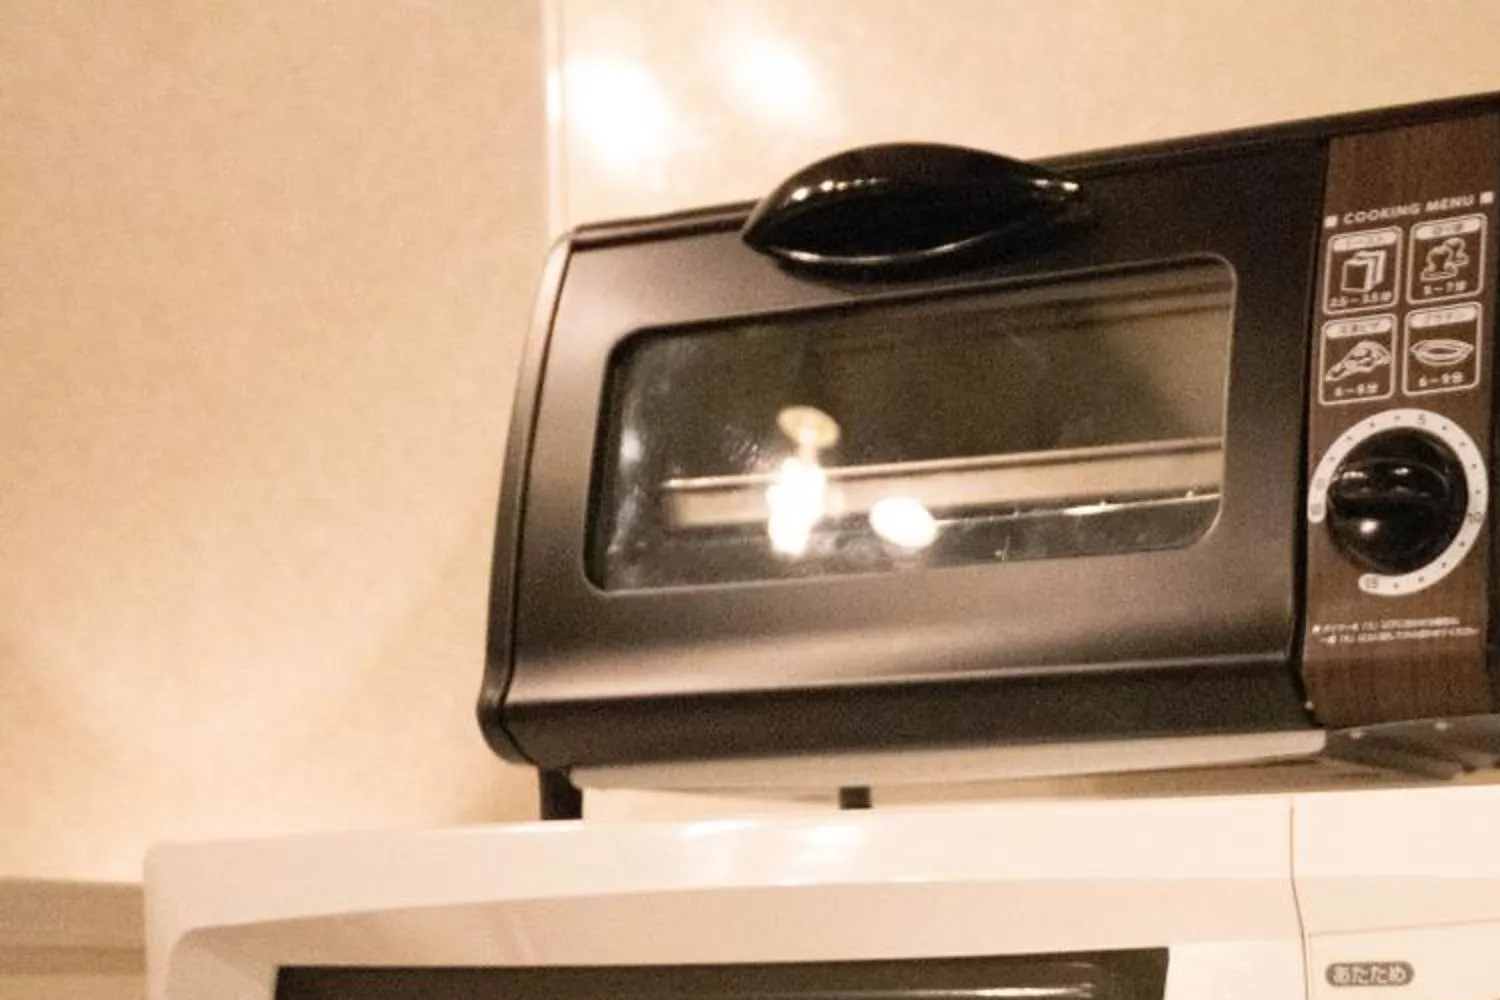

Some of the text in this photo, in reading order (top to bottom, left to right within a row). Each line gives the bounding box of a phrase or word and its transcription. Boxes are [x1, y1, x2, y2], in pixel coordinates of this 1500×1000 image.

[1343, 194, 1475, 224] COOKING MENU
[1334, 965, 1407, 984] あたため
